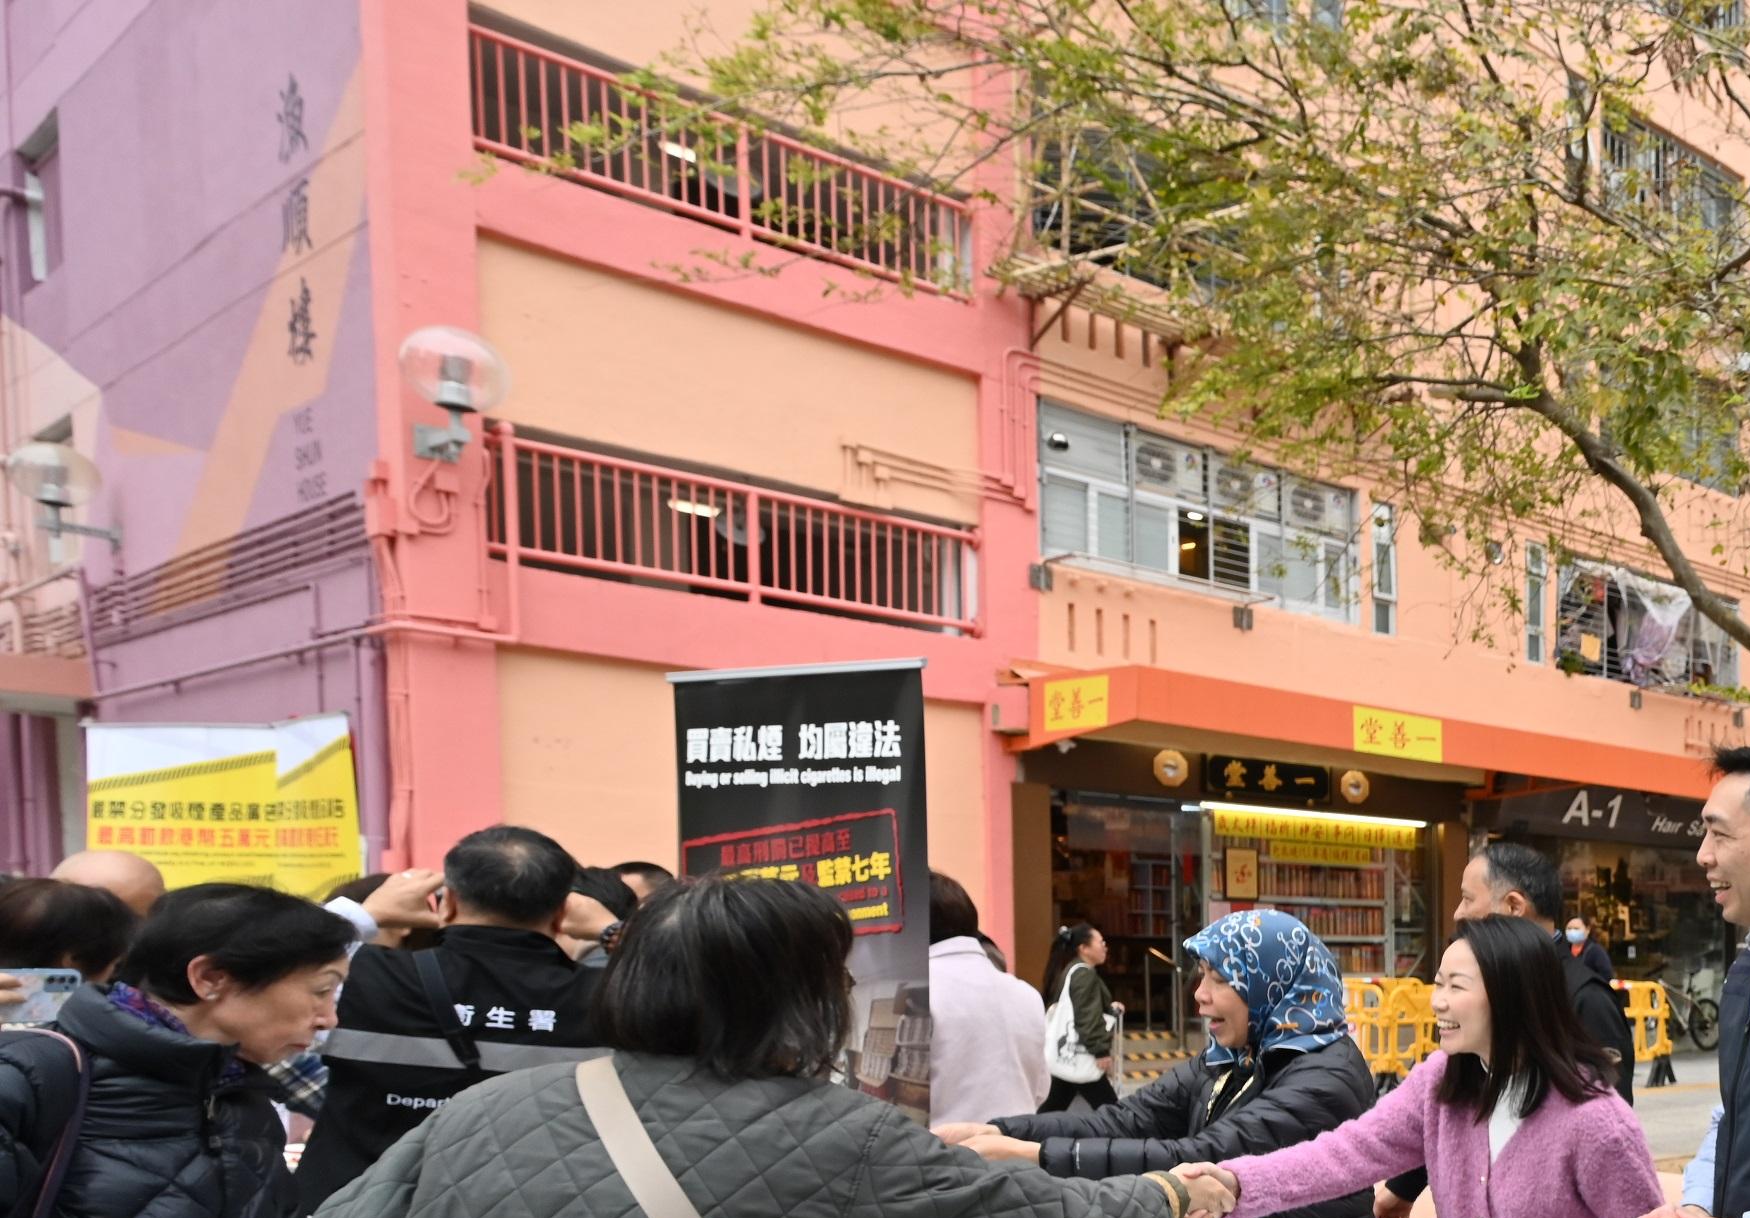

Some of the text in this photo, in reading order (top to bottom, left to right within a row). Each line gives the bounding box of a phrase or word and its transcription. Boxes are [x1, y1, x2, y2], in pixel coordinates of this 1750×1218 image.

[686, 720, 901, 763] 買賣私煙 均屬違法
[1562, 790, 1623, 828] A-1
